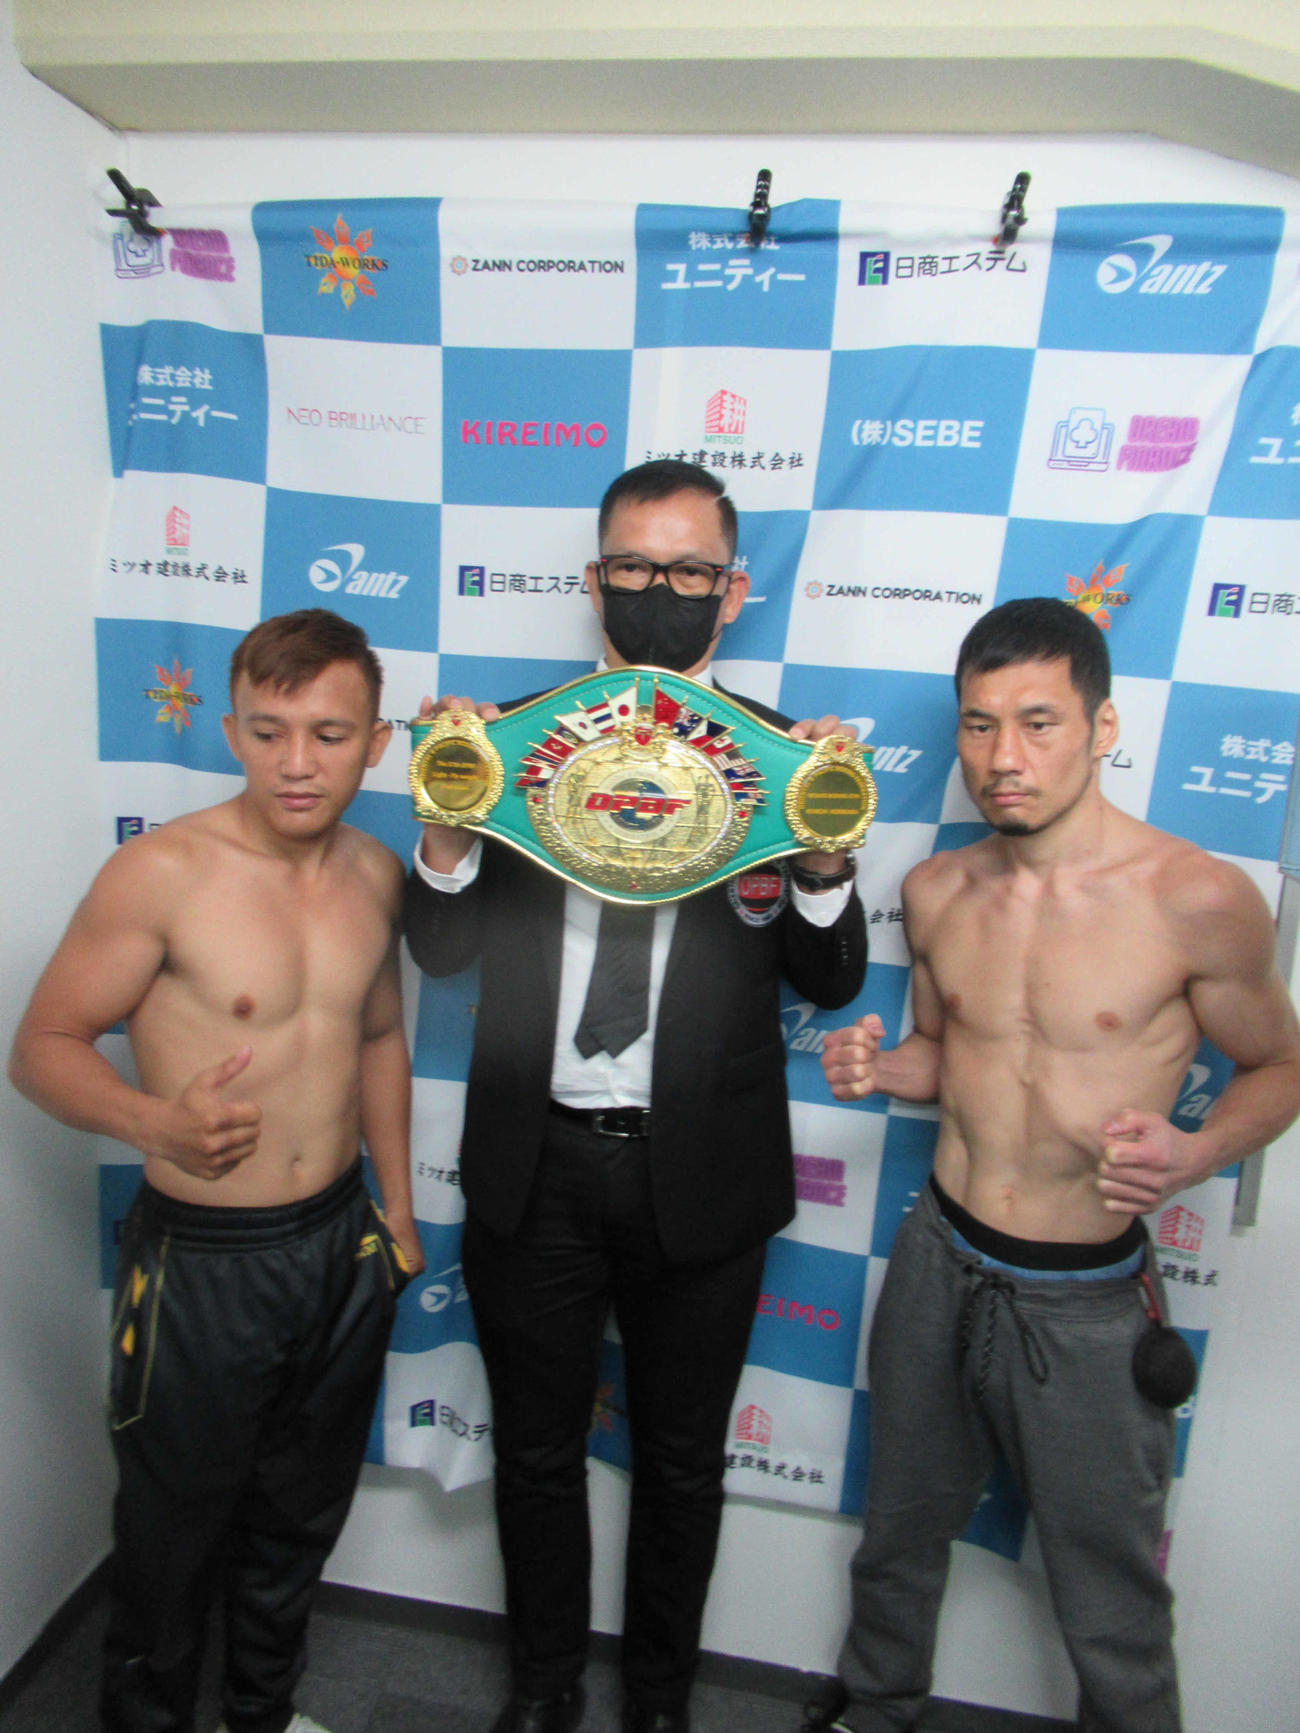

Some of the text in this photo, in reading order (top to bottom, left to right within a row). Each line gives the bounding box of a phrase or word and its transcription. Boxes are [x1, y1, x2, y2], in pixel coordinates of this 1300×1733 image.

[472, 259, 624, 273] ZANN CORPORATION
[661, 258, 806, 292] ユニティー
[895, 250, 1027, 278] 日商エステム
[1138, 261, 1228, 294] antz
[128, 396, 238, 427] ニティー
[286, 407, 428, 434] NEO BRILLIANCE
[461, 420, 607, 448] KIREIMO
[345, 570, 410, 599] antz
[826, 584, 983, 605] ZANN CORPORATION
[1220, 734, 1295, 766] 株式会
[1181, 765, 1288, 804] ユニテ
[739, 876, 778, 897] OPBF
[757, 1294, 841, 1331] EIMO
